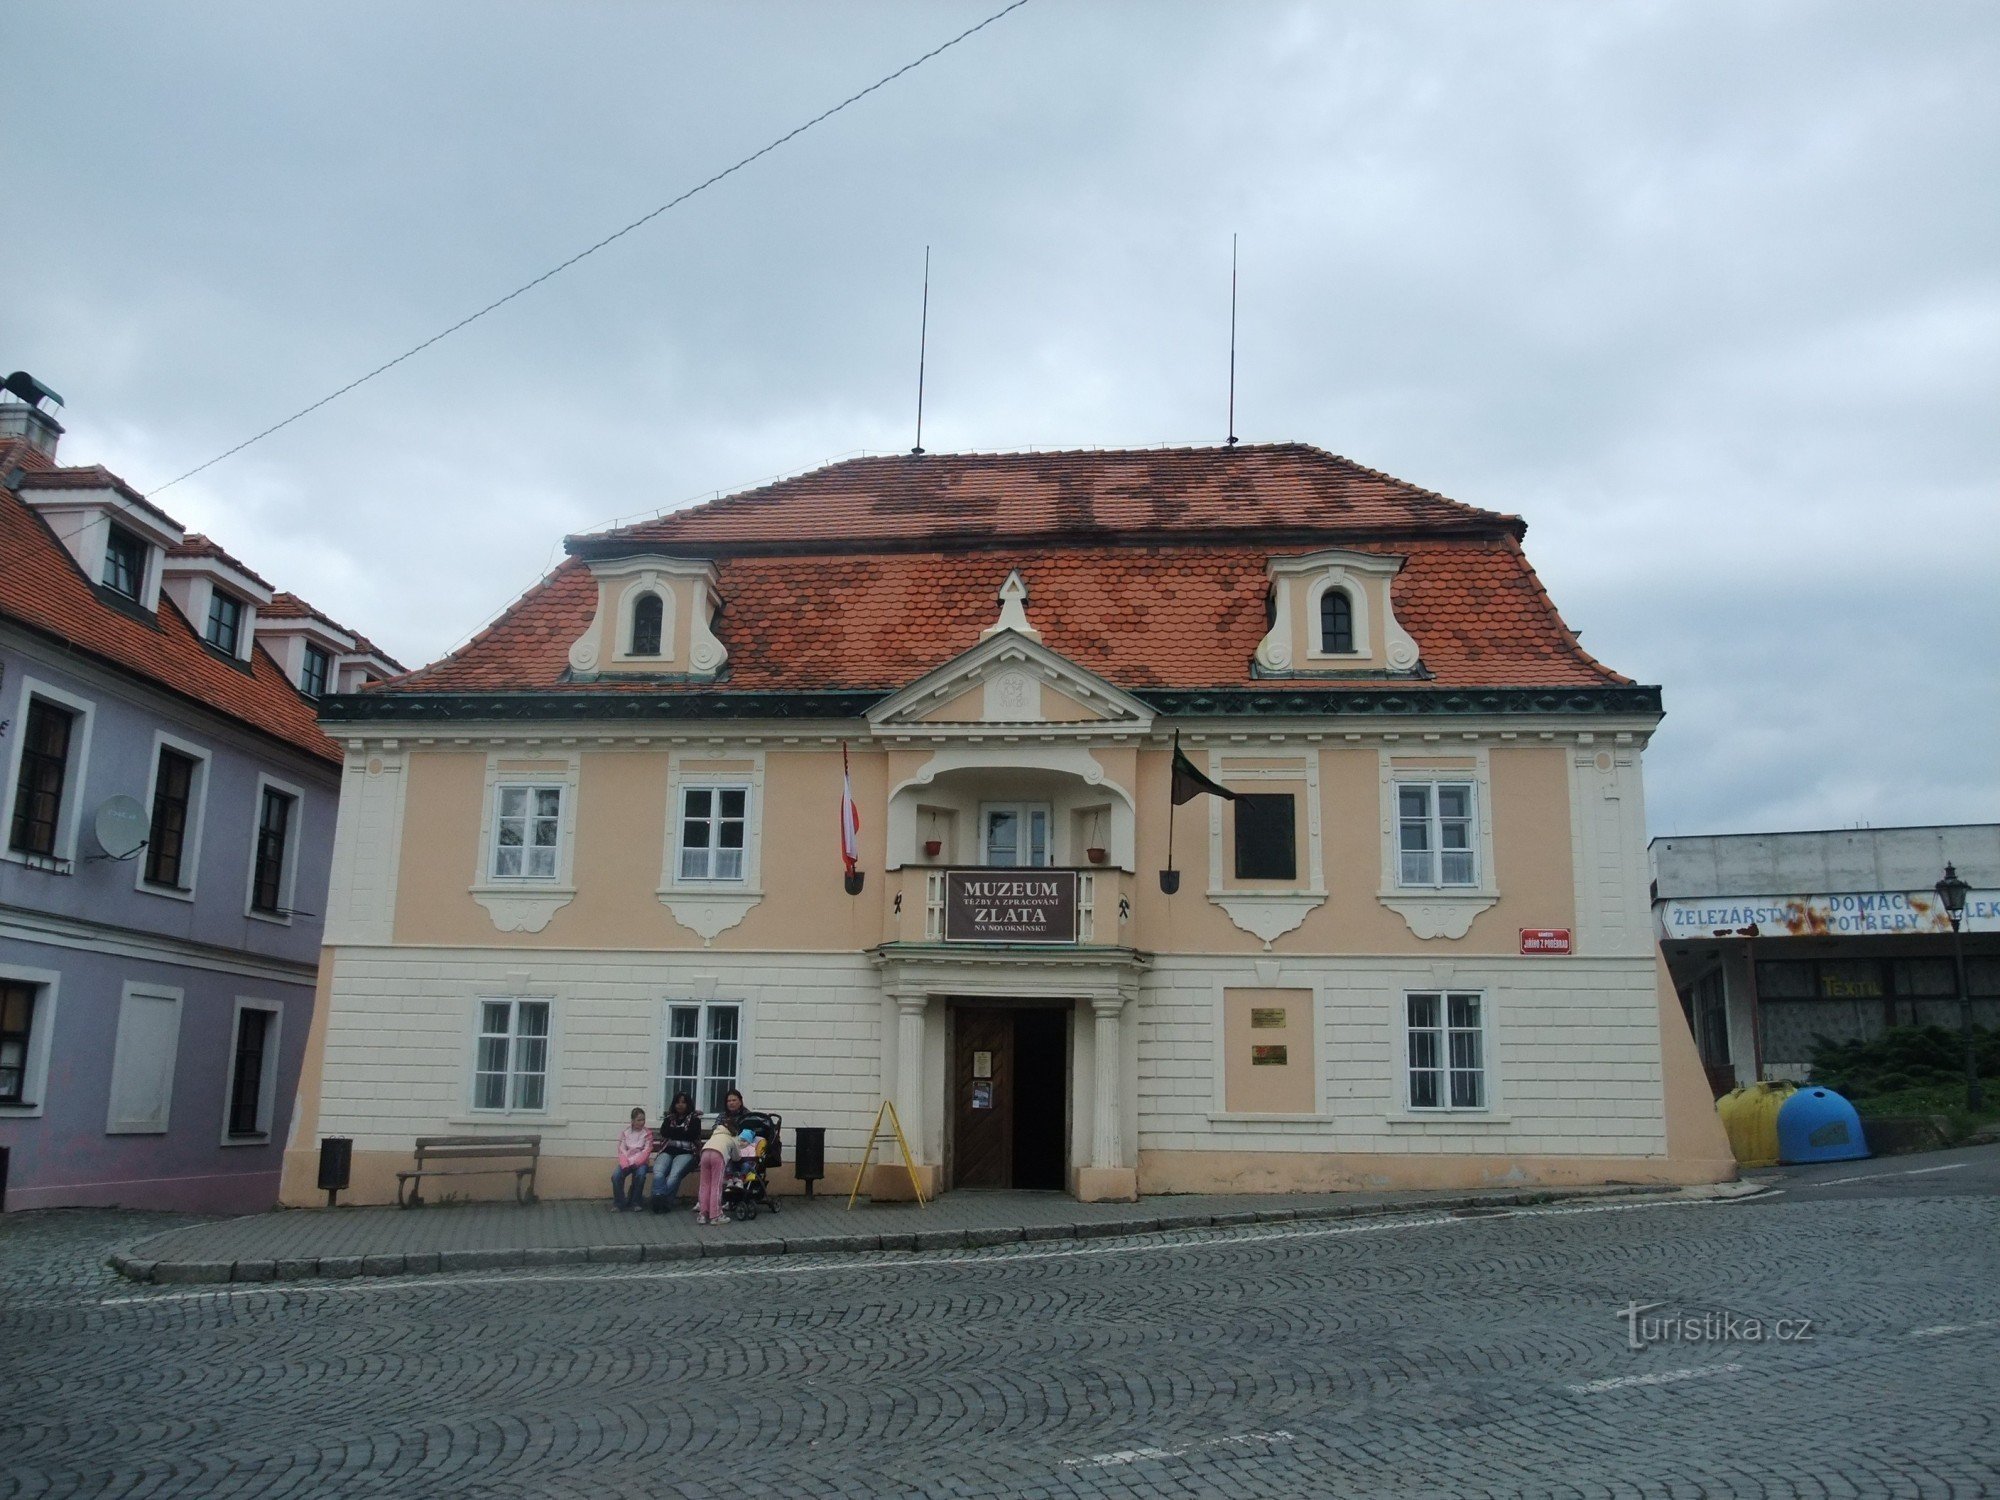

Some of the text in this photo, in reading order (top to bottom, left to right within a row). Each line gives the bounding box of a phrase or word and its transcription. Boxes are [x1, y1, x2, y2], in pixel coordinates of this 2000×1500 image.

[964, 882, 1058, 896] MUZEUM
[963, 898, 992, 906] TĚŽBY
[1003, 898, 1059, 906] ZPRACOVÁNÍ
[974, 908, 1047, 923] ZLATA
